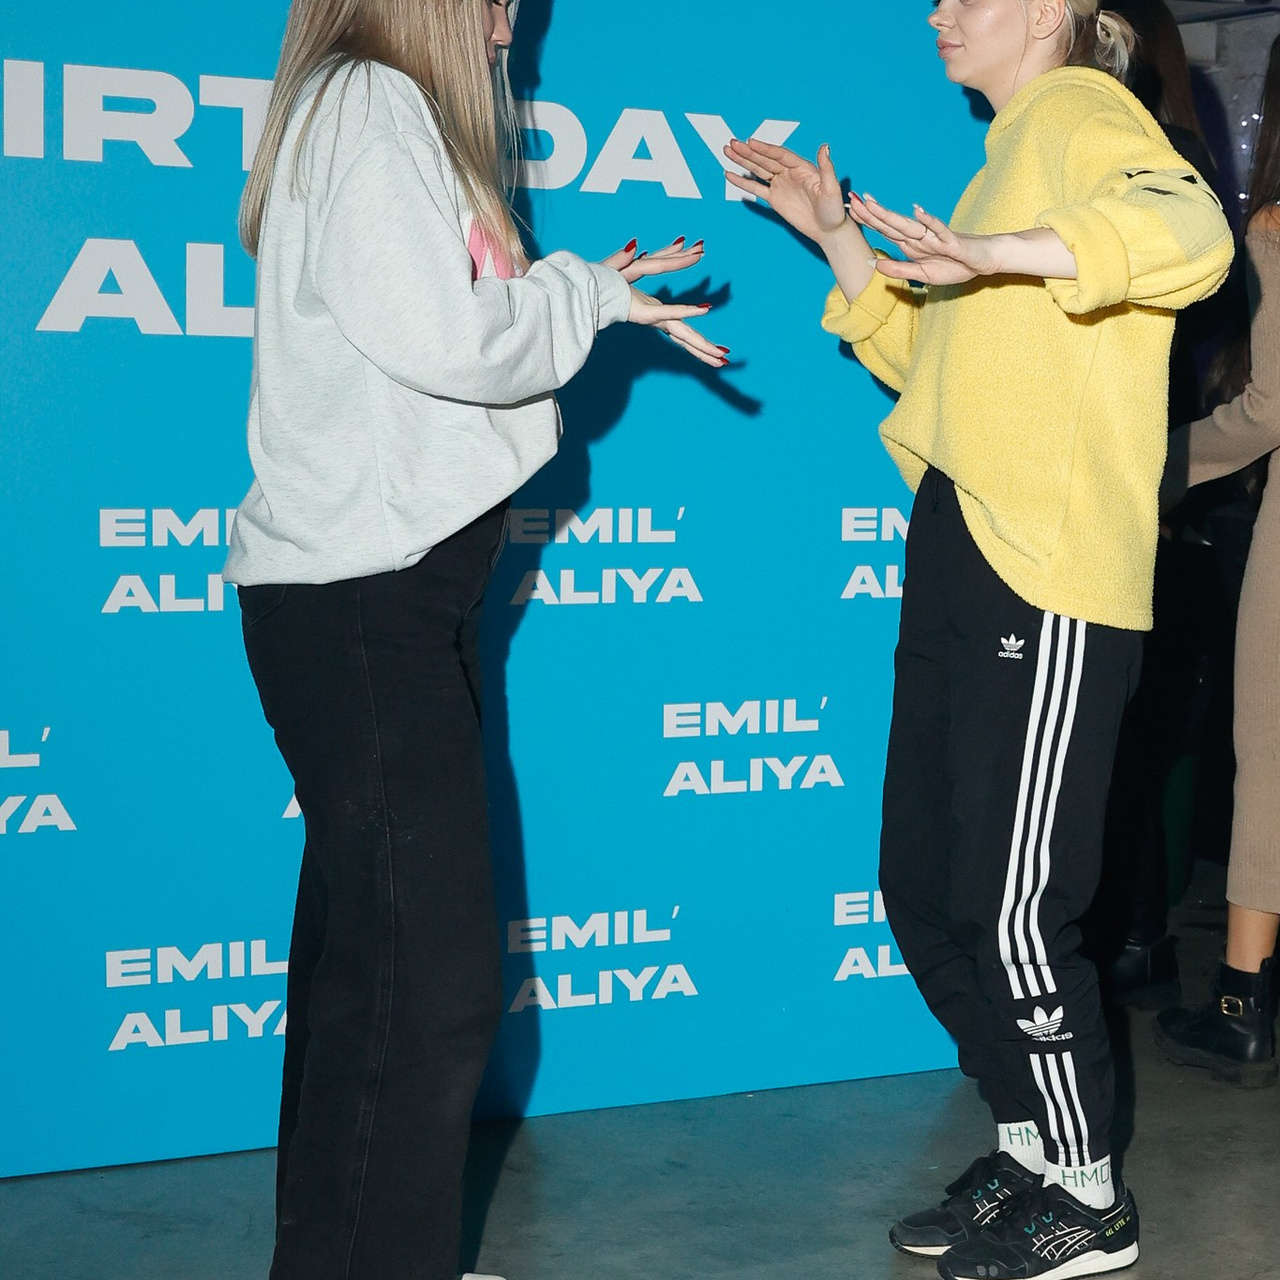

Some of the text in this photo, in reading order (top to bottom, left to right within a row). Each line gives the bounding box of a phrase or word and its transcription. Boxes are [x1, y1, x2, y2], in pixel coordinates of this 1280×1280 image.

[101, 574, 236, 613] ALI
[509, 568, 704, 605] ALIYA
[997, 651, 1024, 660] adidas
[664, 754, 844, 796] ALIYA
[106, 940, 289, 988] EMIL
[508, 963, 699, 1014] ALIYA
